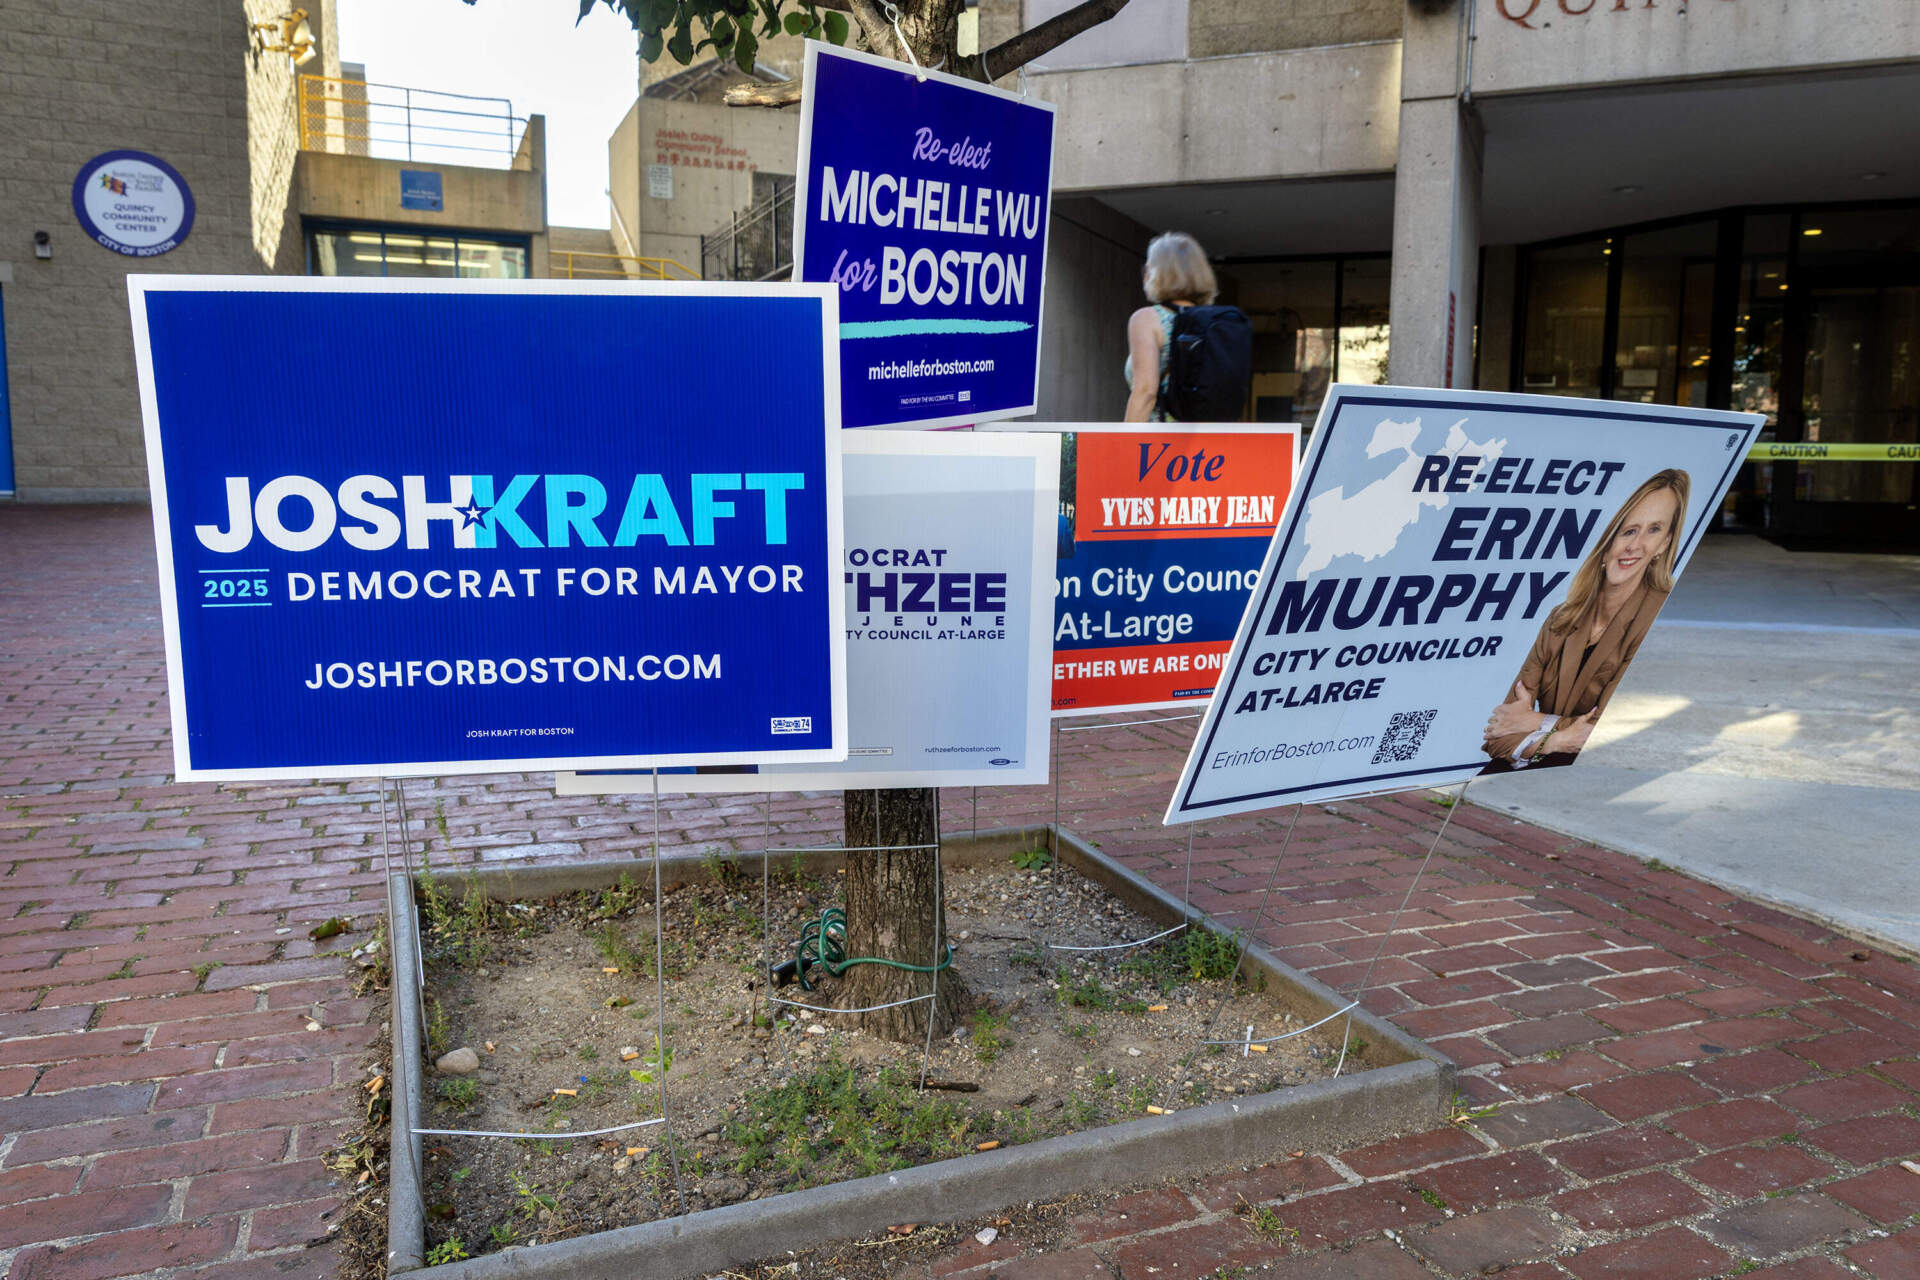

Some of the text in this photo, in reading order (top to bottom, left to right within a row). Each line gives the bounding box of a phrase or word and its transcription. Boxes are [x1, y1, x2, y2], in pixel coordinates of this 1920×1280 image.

[913, 126, 992, 170] Re-elect
[102, 212, 168, 223] COMMUNITY
[114, 203, 154, 213] QUINCY
[820, 166, 1041, 239] MICHELLE WU
[115, 223, 157, 232] CENTER
[97, 235, 177, 256] CITY OF BOSTON
[829, 246, 1027, 306] for BOSTON
[868, 359, 995, 380] michelleforboston.com
[1138, 443, 1225, 482] Vote
[1769, 445, 1828, 457] CAUTION
[1412, 455, 1625, 496] RE-ELECT
[195, 473, 805, 553] JOSH KRAFT
[1101, 496, 1275, 527] YVES MARY JEAN
[1432, 507, 1602, 562] ERIN
[844, 548, 947, 567] OCRAT
[204, 579, 268, 598] 2025
[288, 565, 804, 602] DEMOCRAT FOR MAYOR
[845, 572, 1006, 612] HZEE
[1092, 567, 1154, 602] City
[1265, 571, 1570, 636] MURPHY
[868, 630, 932, 640] COUNCIL
[938, 629, 1005, 640] AT-LARGE
[1055, 610, 1193, 642] At-Large
[305, 654, 722, 689] JOSHFORBOSTON.COM
[1120, 658, 1149, 676] WE
[1153, 655, 1189, 673] ARE
[1253, 636, 1503, 676] CITY COUNCILOR
[1235, 677, 1386, 714] AT-LARGE
[466, 727, 574, 738] JOSH KRAFT FOR BOSTON
[925, 745, 1001, 753] ruthzeeforboston.com
[1212, 733, 1375, 770] ErinforBoston.com
